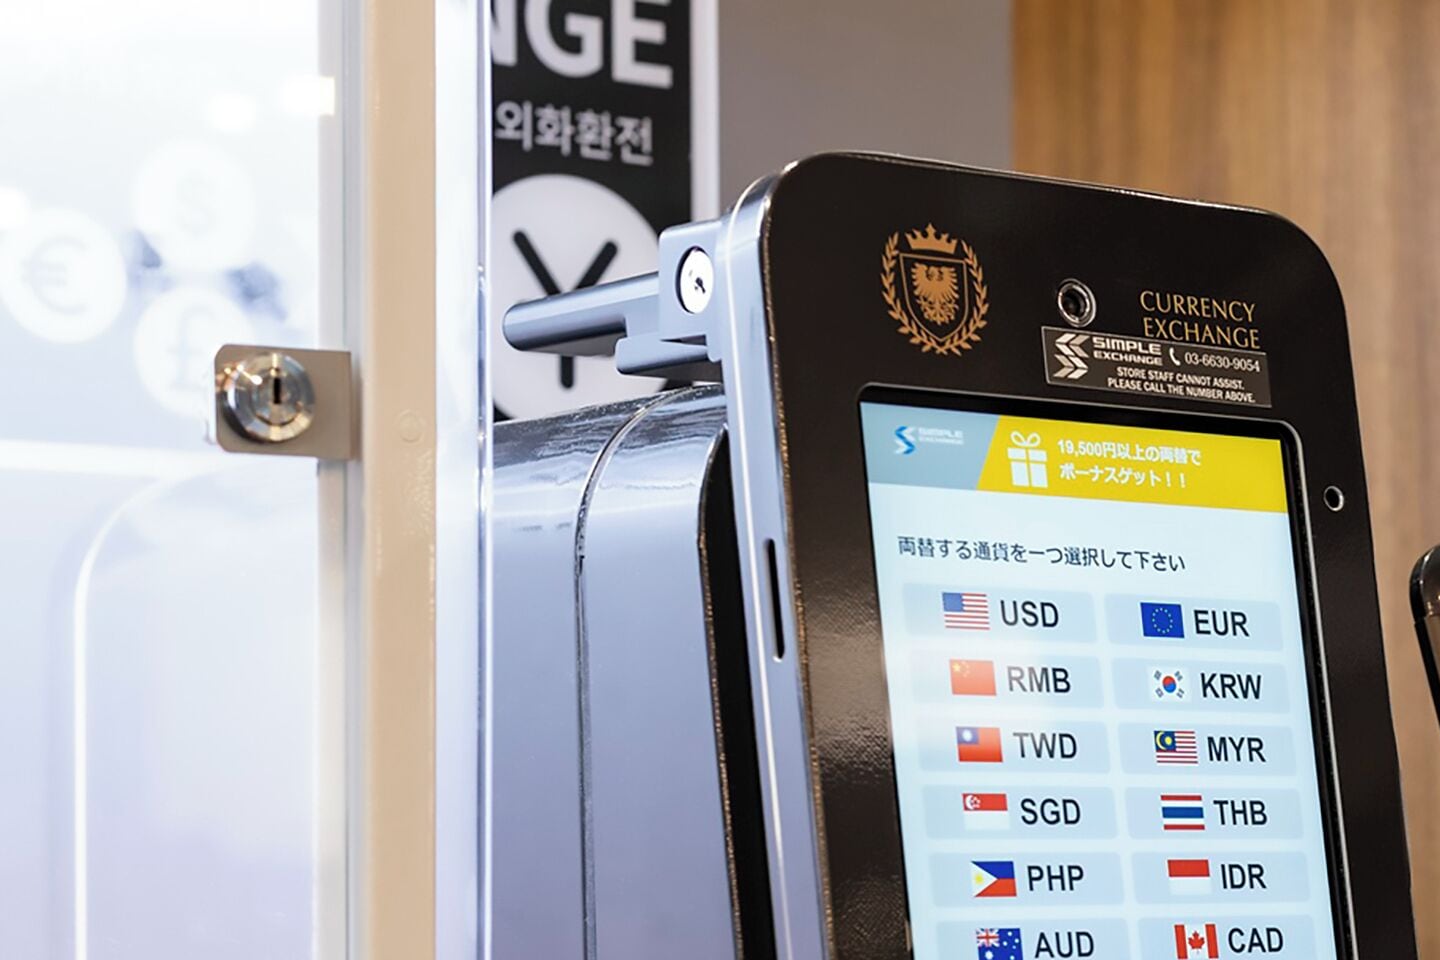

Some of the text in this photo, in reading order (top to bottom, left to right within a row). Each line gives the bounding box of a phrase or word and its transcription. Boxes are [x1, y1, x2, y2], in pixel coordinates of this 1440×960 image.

[494, 100, 654, 167] 외화환전
[1140, 290, 1256, 323] CURRENCY
[1143, 316, 1261, 350] EXCHANGE
[1093, 336, 1261, 373] SIMPLE 03-6630-9054
[1094, 351, 1163, 366] EXCHANGE
[1107, 377, 1256, 403] PLEASE CALL THE NUMBER ABOVE.
[1117, 366, 1245, 390] STORE STAFF CANNOT ASSIST.
[897, 535, 1187, 572] 両替する通貨を一つ選択して下さい
[1000, 600, 1060, 629] USD
[1193, 609, 1250, 638] EUR
[1007, 665, 1071, 694] RMB
[1200, 672, 1262, 700] KRW
[1013, 731, 1078, 760] TWD
[1207, 736, 1267, 763] MYR
[1020, 797, 1081, 826] SGD
[1213, 799, 1268, 827] THB
[1027, 864, 1084, 892] PHP
[1221, 862, 1267, 890] IDR
[1034, 930, 1095, 959] AUD
[1227, 926, 1284, 954] CAD
